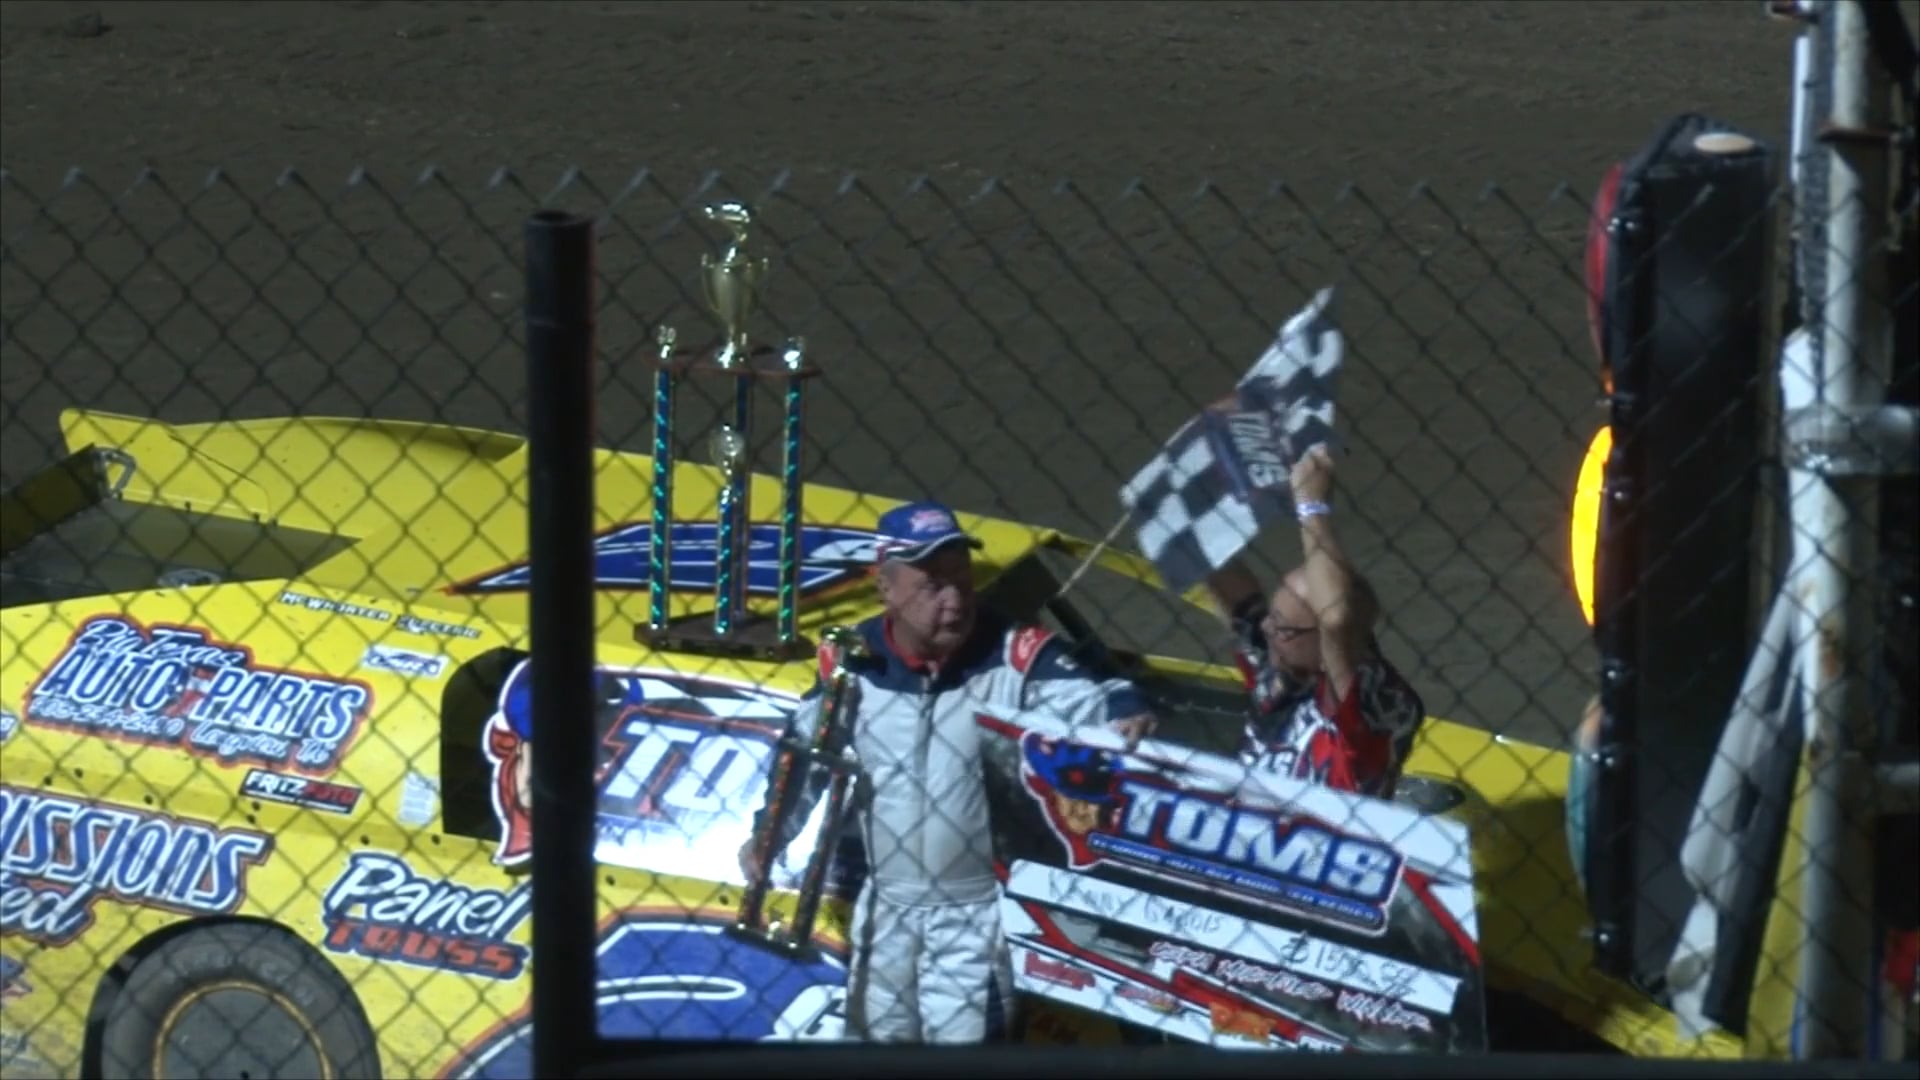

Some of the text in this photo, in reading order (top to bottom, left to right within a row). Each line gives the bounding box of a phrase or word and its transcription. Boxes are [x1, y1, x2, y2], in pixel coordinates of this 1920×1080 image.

[140, 629, 245, 667] Texas
[34, 646, 367, 742] AUTO PARTS
[0, 790, 266, 911] ISSIONS
[1119, 780, 1392, 897] TOMS
[329, 857, 532, 938] Panel
[329, 919, 515, 972] TRUSS
